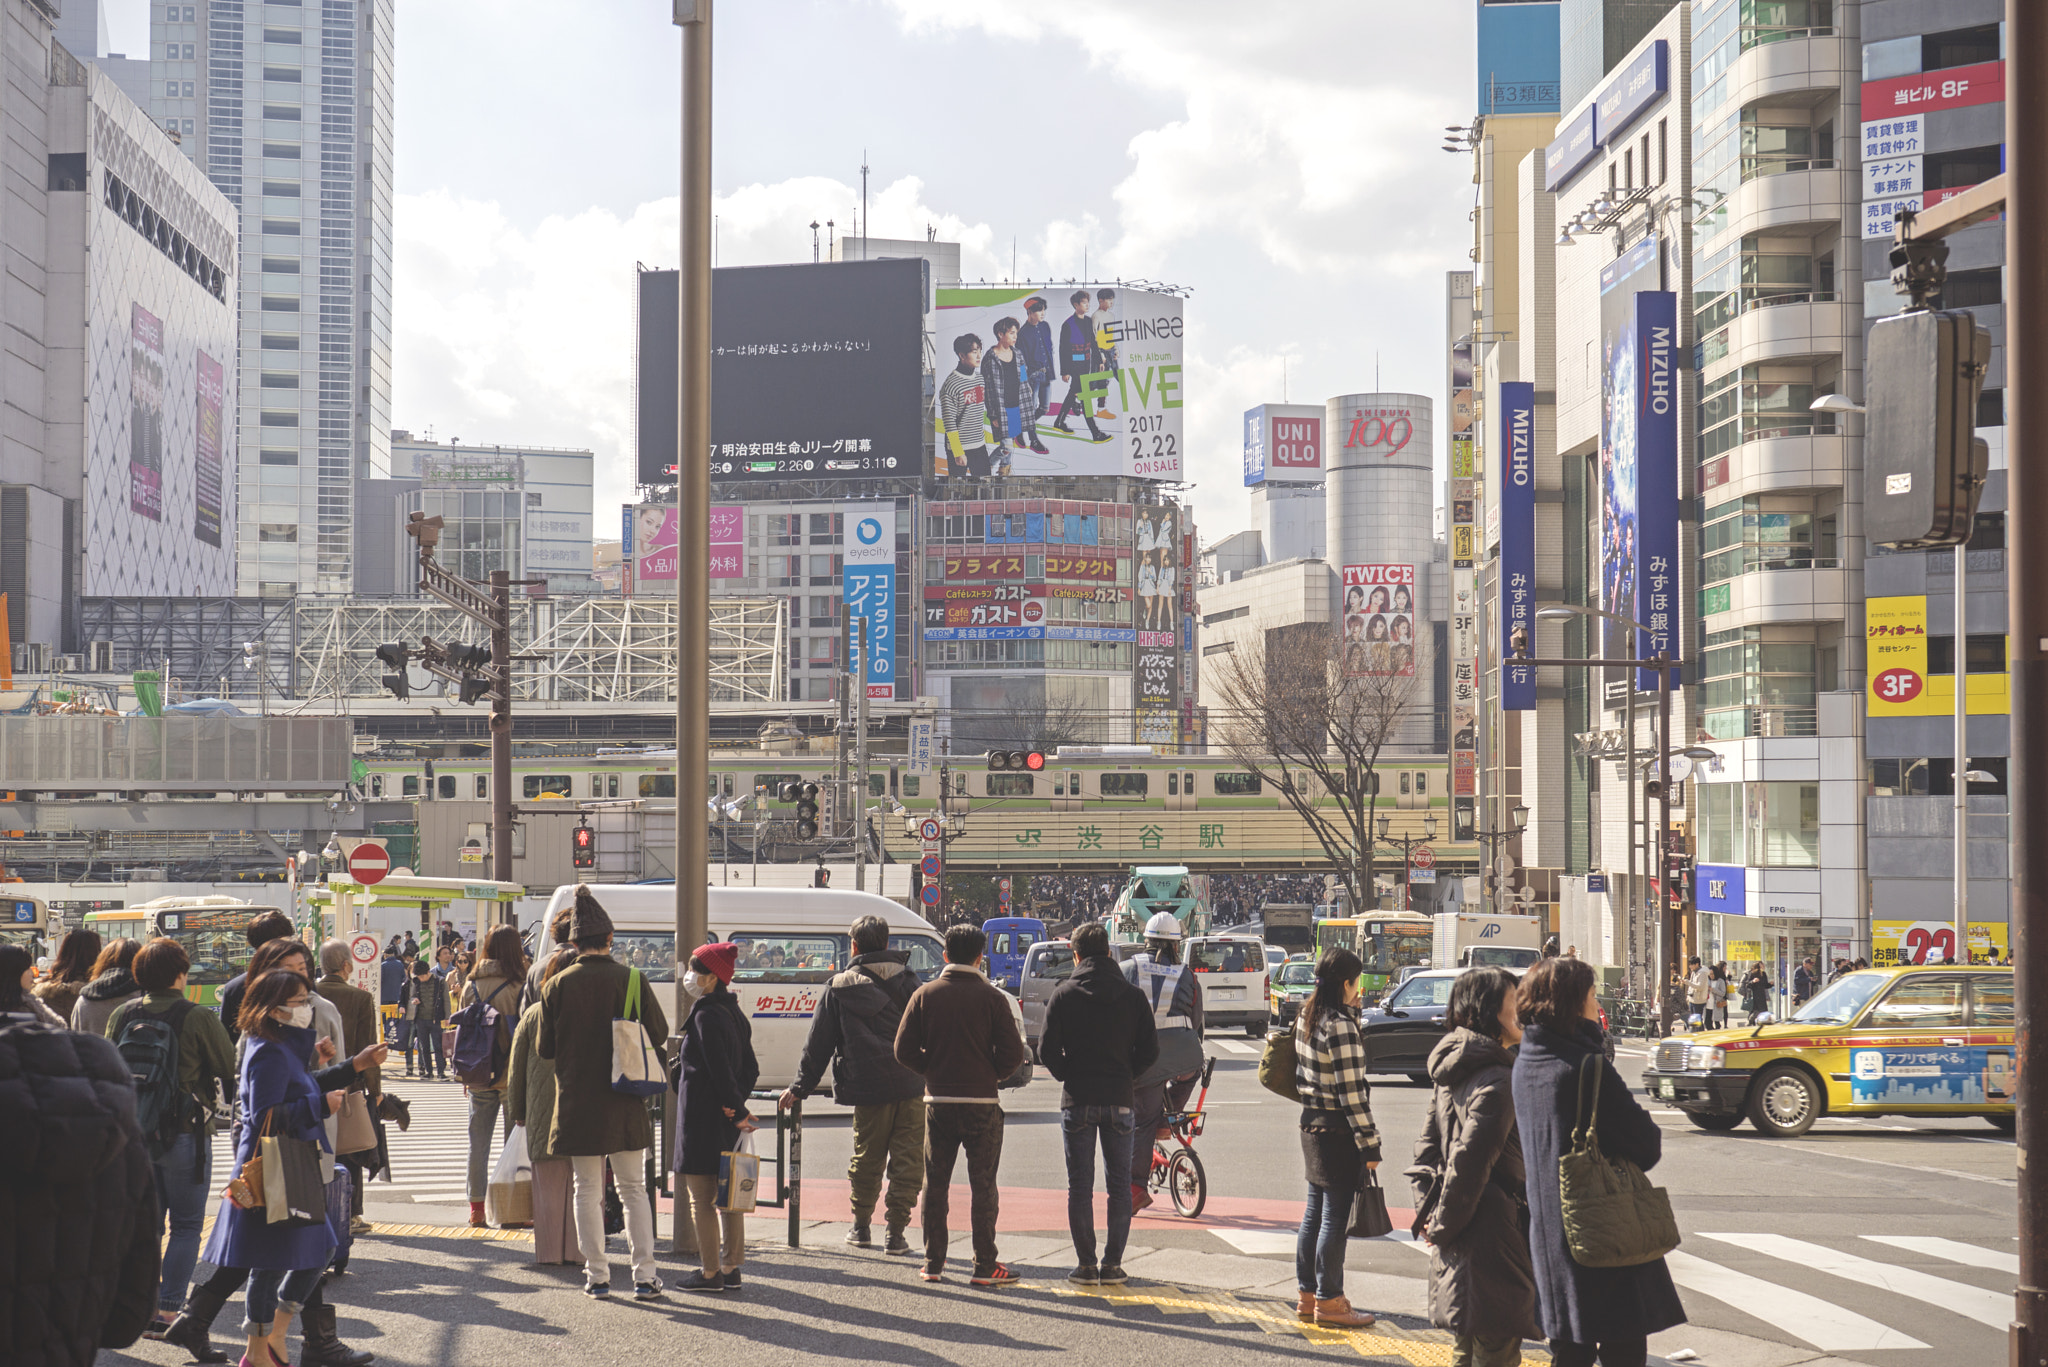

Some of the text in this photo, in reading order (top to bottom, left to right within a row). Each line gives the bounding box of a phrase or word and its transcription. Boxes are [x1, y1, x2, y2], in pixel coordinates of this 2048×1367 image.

[1894, 80, 1969, 105] 当ビル 8F
[1866, 120, 1918, 139] 賃貸管理
[1866, 138, 1918, 157] 賃貸仲介
[1869, 160, 1916, 177] テナント
[1874, 178, 1912, 194] 事務所
[1867, 221, 1896, 235] 社宅
[711, 339, 871, 356] カーは何が起こるかわからない」
[1130, 352, 1172, 363] 5th Album
[1651, 326, 1670, 415] MIZUHO
[1077, 364, 1183, 418] FIVE
[1356, 409, 1411, 417] SHIBUYA
[1129, 415, 1163, 434] 2017
[1277, 423, 1311, 441] UNI
[1343, 416, 1413, 458] 109
[722, 438, 872, 457] 明治安田生命Jリーグ開幕
[1131, 433, 1177, 459] 2.22
[1277, 444, 1315, 464] QLO
[1513, 408, 1529, 487] MIZUHO
[1134, 459, 1178, 475] ON SALE
[850, 546, 888, 560] eyecity
[946, 558, 1022, 575] プライス
[1046, 558, 1114, 576] コンタクト
[1344, 566, 1413, 584] TWICE
[994, 585, 1031, 601] ガスト
[1094, 587, 1127, 603] ガスト
[1649, 556, 1670, 651] みずほ銀行
[926, 608, 944, 620] 7F
[948, 607, 969, 617] Café
[970, 605, 1017, 625] ガスト
[1025, 609, 1042, 617] ガスト
[874, 575, 889, 674] コンタクトの
[1455, 617, 1472, 630] 3F
[1869, 625, 1924, 638] シティホーム
[927, 629, 951, 638] AEON
[957, 629, 1025, 639] 英会話イーオン
[1050, 628, 1134, 640] AEON 英会話イーオン
[1138, 631, 1174, 647] HKT48
[1878, 645, 1917, 653] 渋谷センター
[1138, 654, 1175, 668] バグって
[1145, 668, 1168, 680] いい
[1143, 682, 1169, 695] じゃん
[1882, 675, 1913, 697] 3F
[918, 724, 931, 772] 宮益坂下
[1016, 829, 1042, 842] JR
[1709, 880, 1727, 900] DHC
[1873, 948, 1909, 961] お部屋
[756, 995, 818, 1011] ゆうパッ
[1809, 1037, 1847, 1046] TAXI
[1886, 1053, 1965, 1065] アプリで呼べる。
